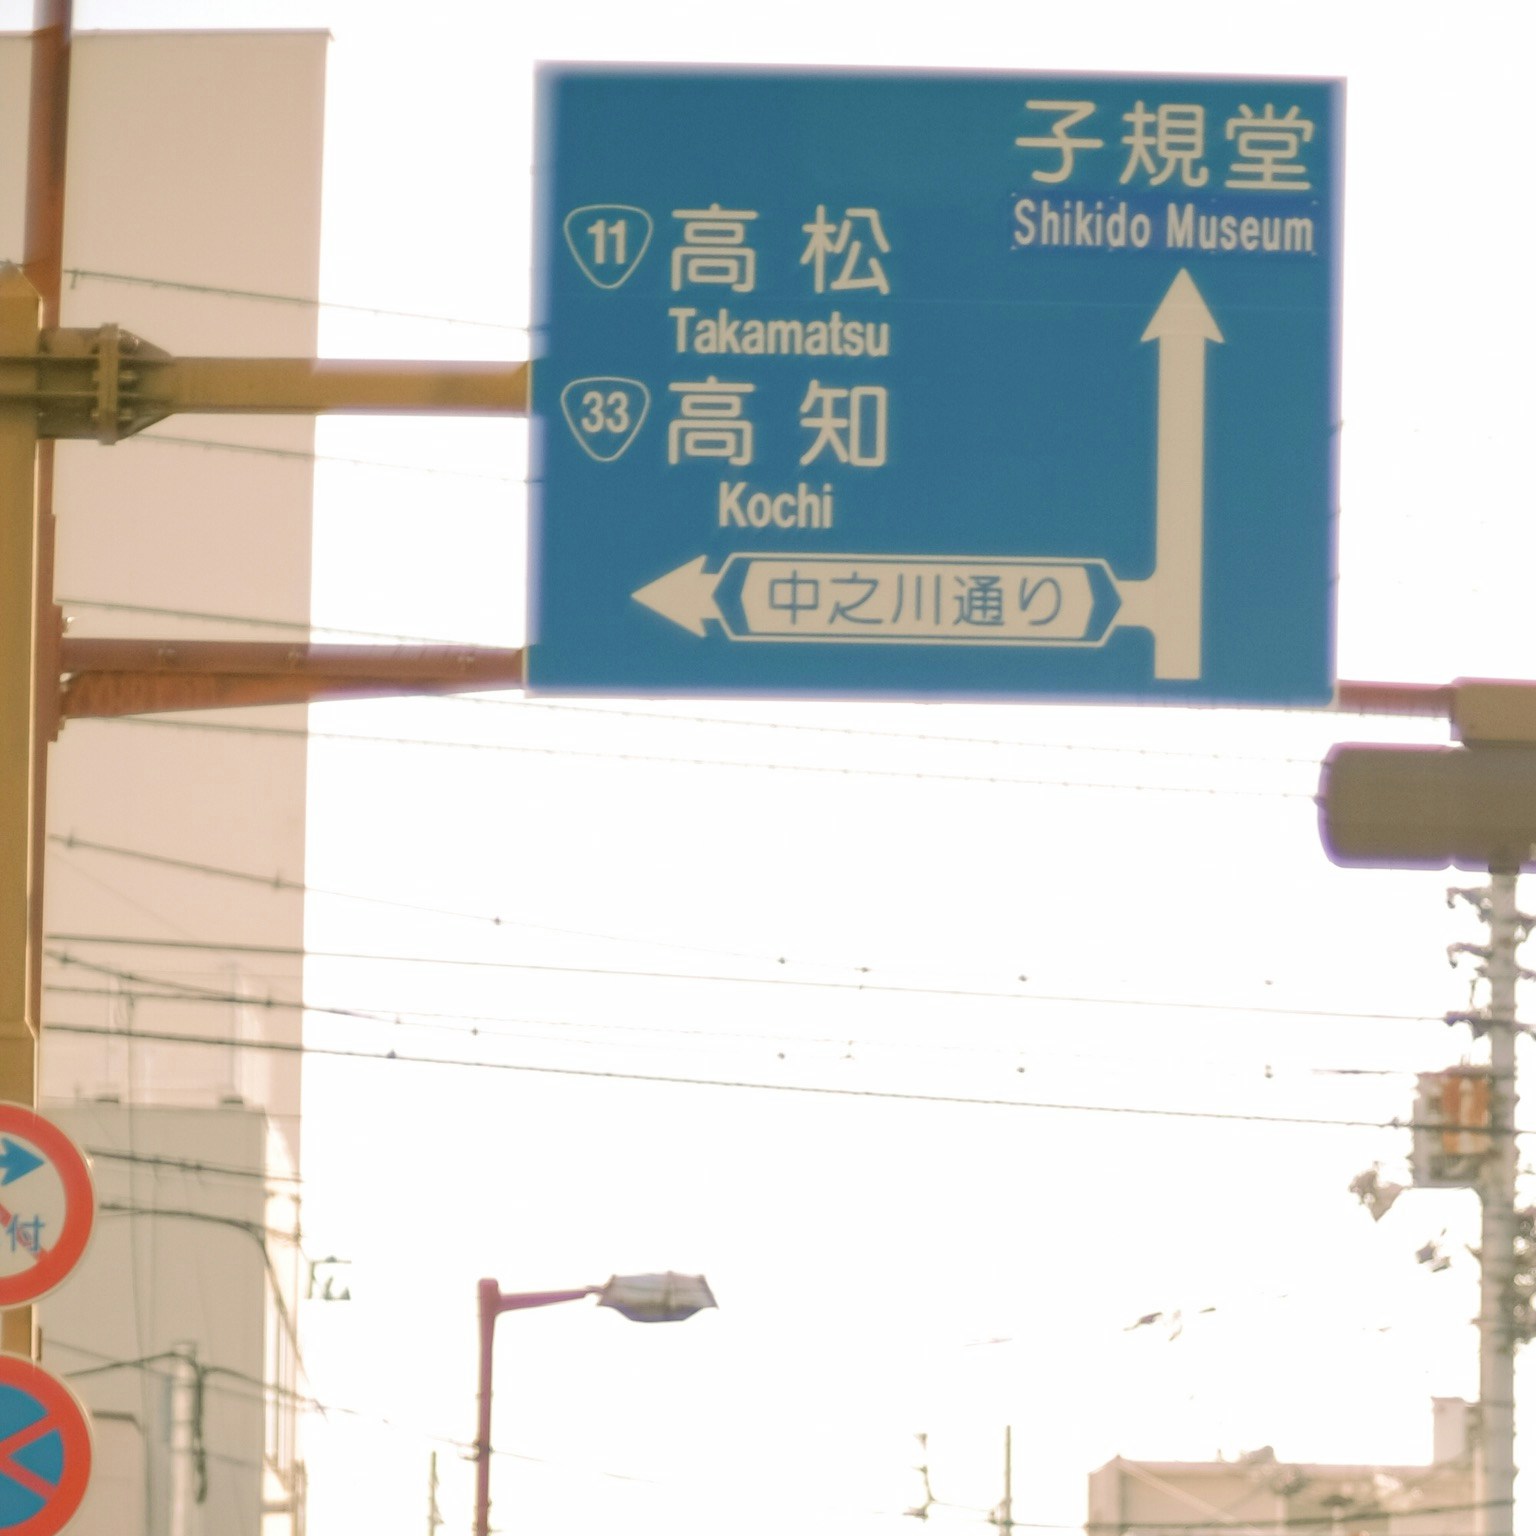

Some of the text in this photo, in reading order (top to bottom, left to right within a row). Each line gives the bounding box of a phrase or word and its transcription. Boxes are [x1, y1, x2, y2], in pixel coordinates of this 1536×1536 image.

[1014, 100, 1315, 191] 子規堂
[586, 220, 629, 265] 11
[670, 202, 891, 295] 高松
[1013, 198, 1315, 254] Shikido Museum
[668, 307, 890, 357] Takamatsu
[580, 391, 630, 433] 33
[667, 375, 888, 468] 高知
[718, 482, 833, 530] Kochi
[768, 573, 1064, 629] 中之川通り
